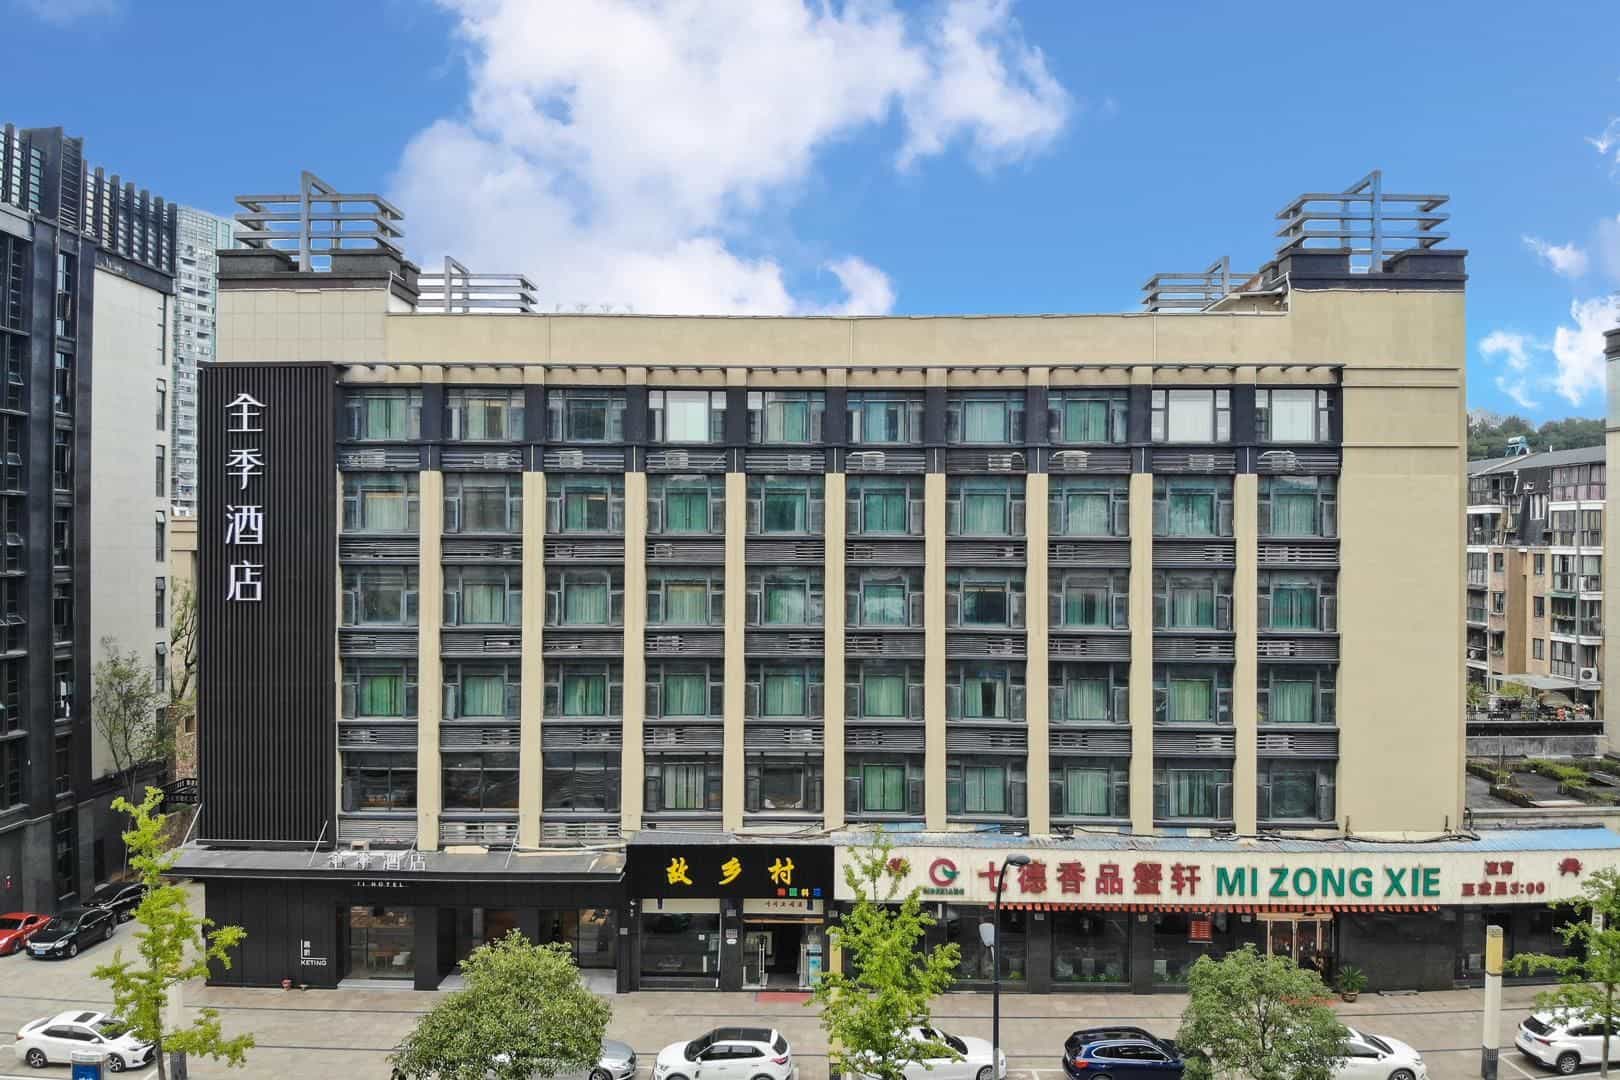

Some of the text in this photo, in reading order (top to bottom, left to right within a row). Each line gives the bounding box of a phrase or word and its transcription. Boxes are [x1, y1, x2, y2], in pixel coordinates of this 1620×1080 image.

[225, 393, 266, 601] 全季酒店
[666, 857, 795, 886] 故乡村
[1216, 867, 1441, 897] MI ZONG XIE
